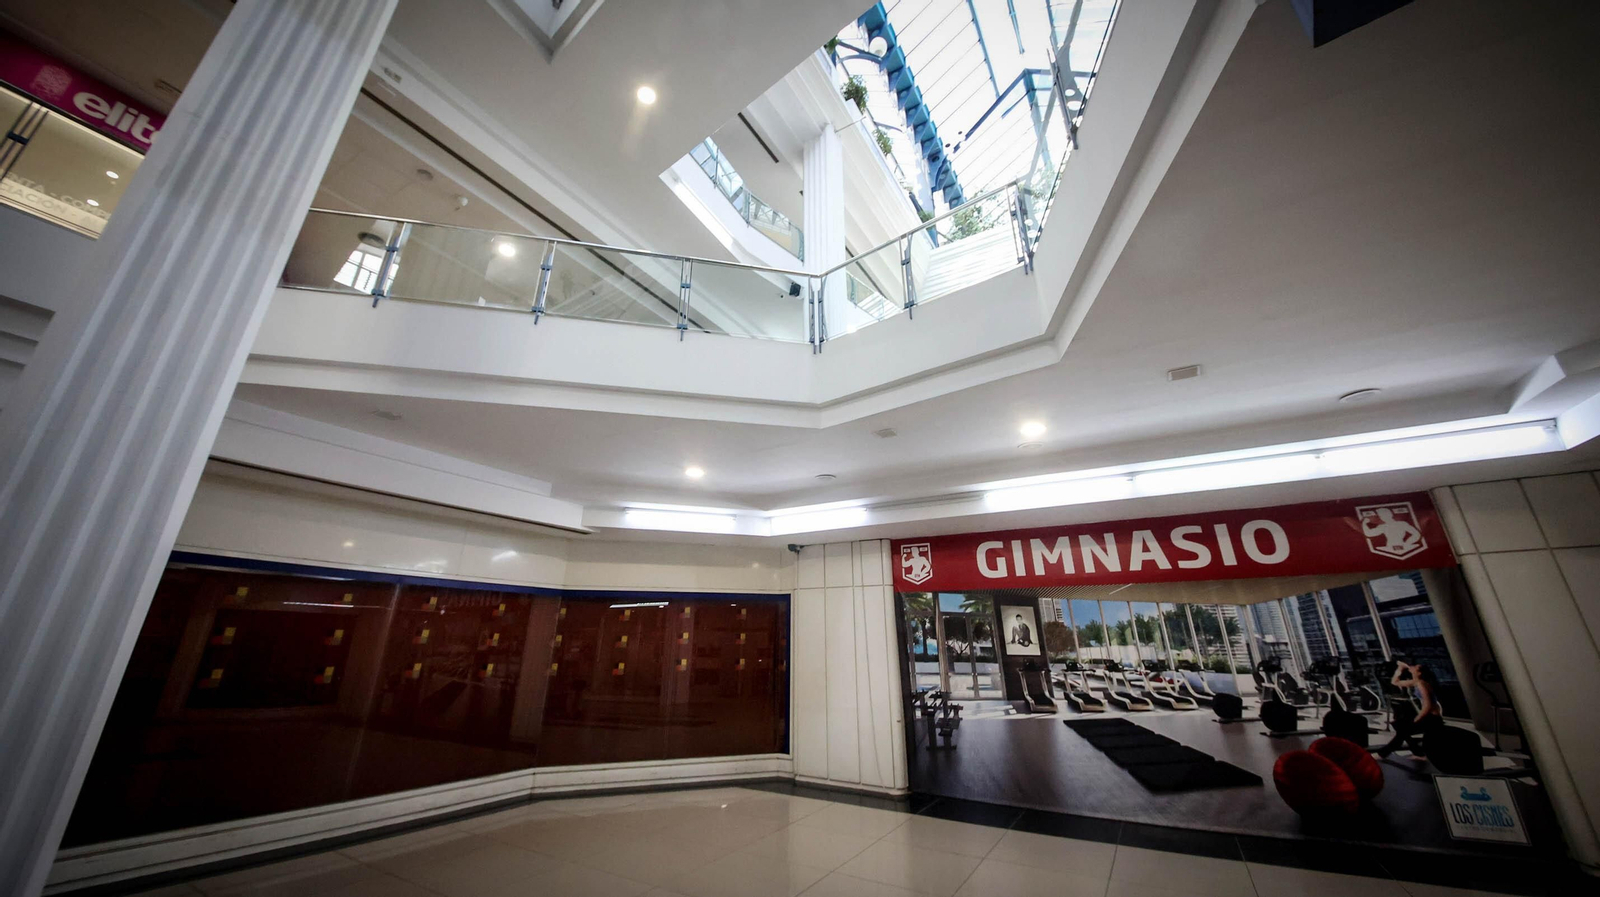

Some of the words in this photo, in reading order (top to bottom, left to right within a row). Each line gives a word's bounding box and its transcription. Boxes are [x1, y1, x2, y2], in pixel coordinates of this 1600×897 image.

[60, 194, 111, 219] COMP
[976, 519, 1291, 579] GIMNASIO
[1449, 802, 1474, 825] LOS
[1472, 803, 1515, 828] CISNES
